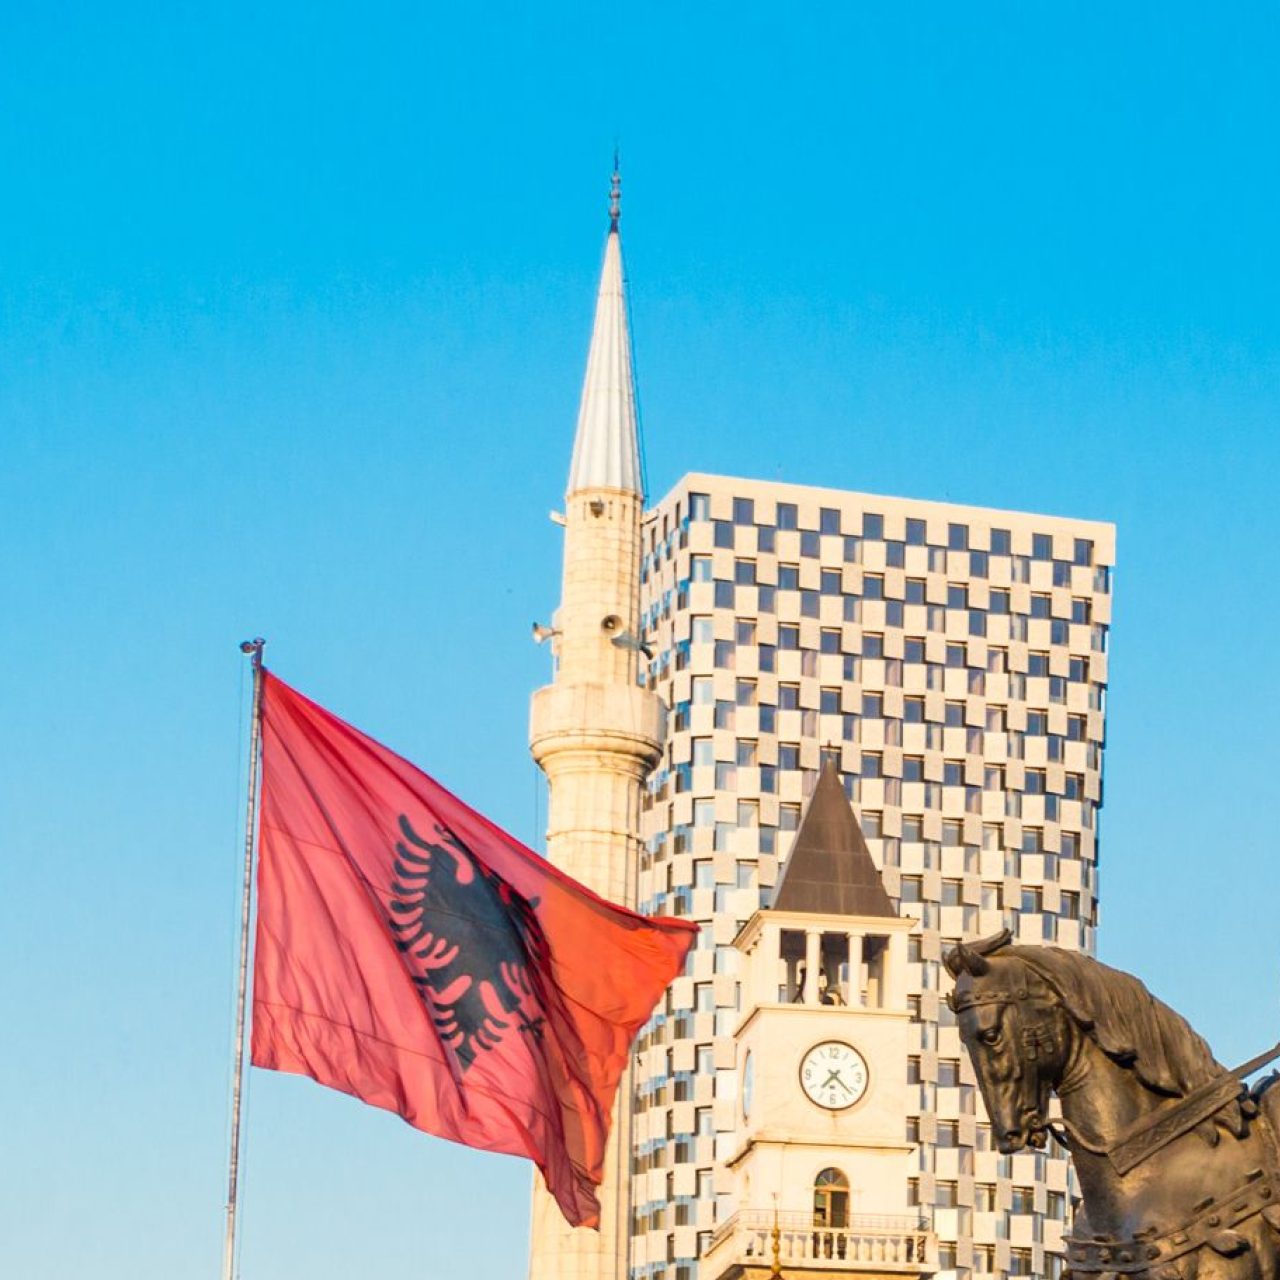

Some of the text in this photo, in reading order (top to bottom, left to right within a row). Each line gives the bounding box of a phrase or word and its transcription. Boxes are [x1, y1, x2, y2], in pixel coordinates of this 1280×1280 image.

[829, 1047, 840, 1059] 12
[805, 1068, 812, 1080] 9
[855, 1072, 862, 1083] 3
[829, 1093, 836, 1104] 6
